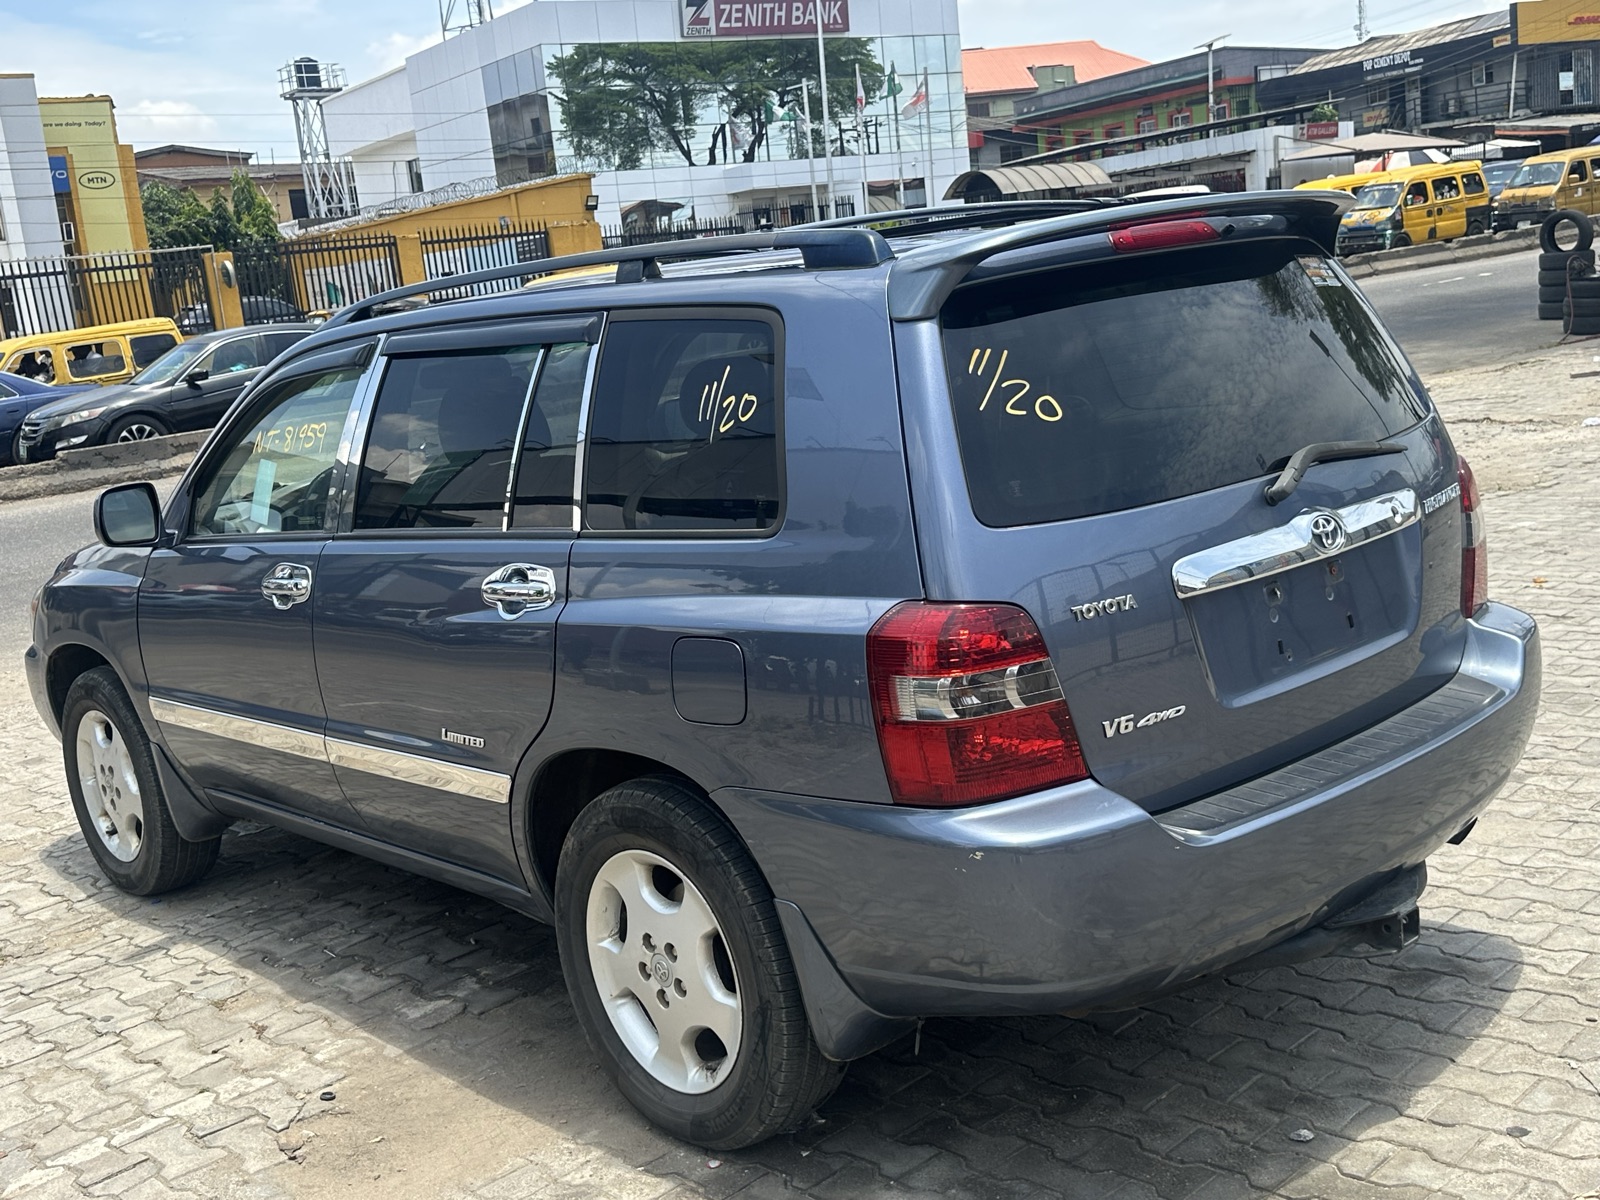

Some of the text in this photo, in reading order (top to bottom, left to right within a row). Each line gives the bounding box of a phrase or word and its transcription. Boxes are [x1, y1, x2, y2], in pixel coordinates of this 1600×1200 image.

[719, 1, 842, 27] ZENITH BANK
[685, 27, 712, 35] ZENITH
[1394, 51, 1411, 65] DEPOT
[1318, 126, 1338, 135] GALLERY
[87, 176, 107, 185] MTN
[968, 348, 1063, 422] 11/20
[698, 364, 757, 444] 11/20
[1070, 594, 1138, 622] TOYOTA
[1102, 705, 1186, 738] V6 4WD
[441, 728, 485, 749] LIMITED
